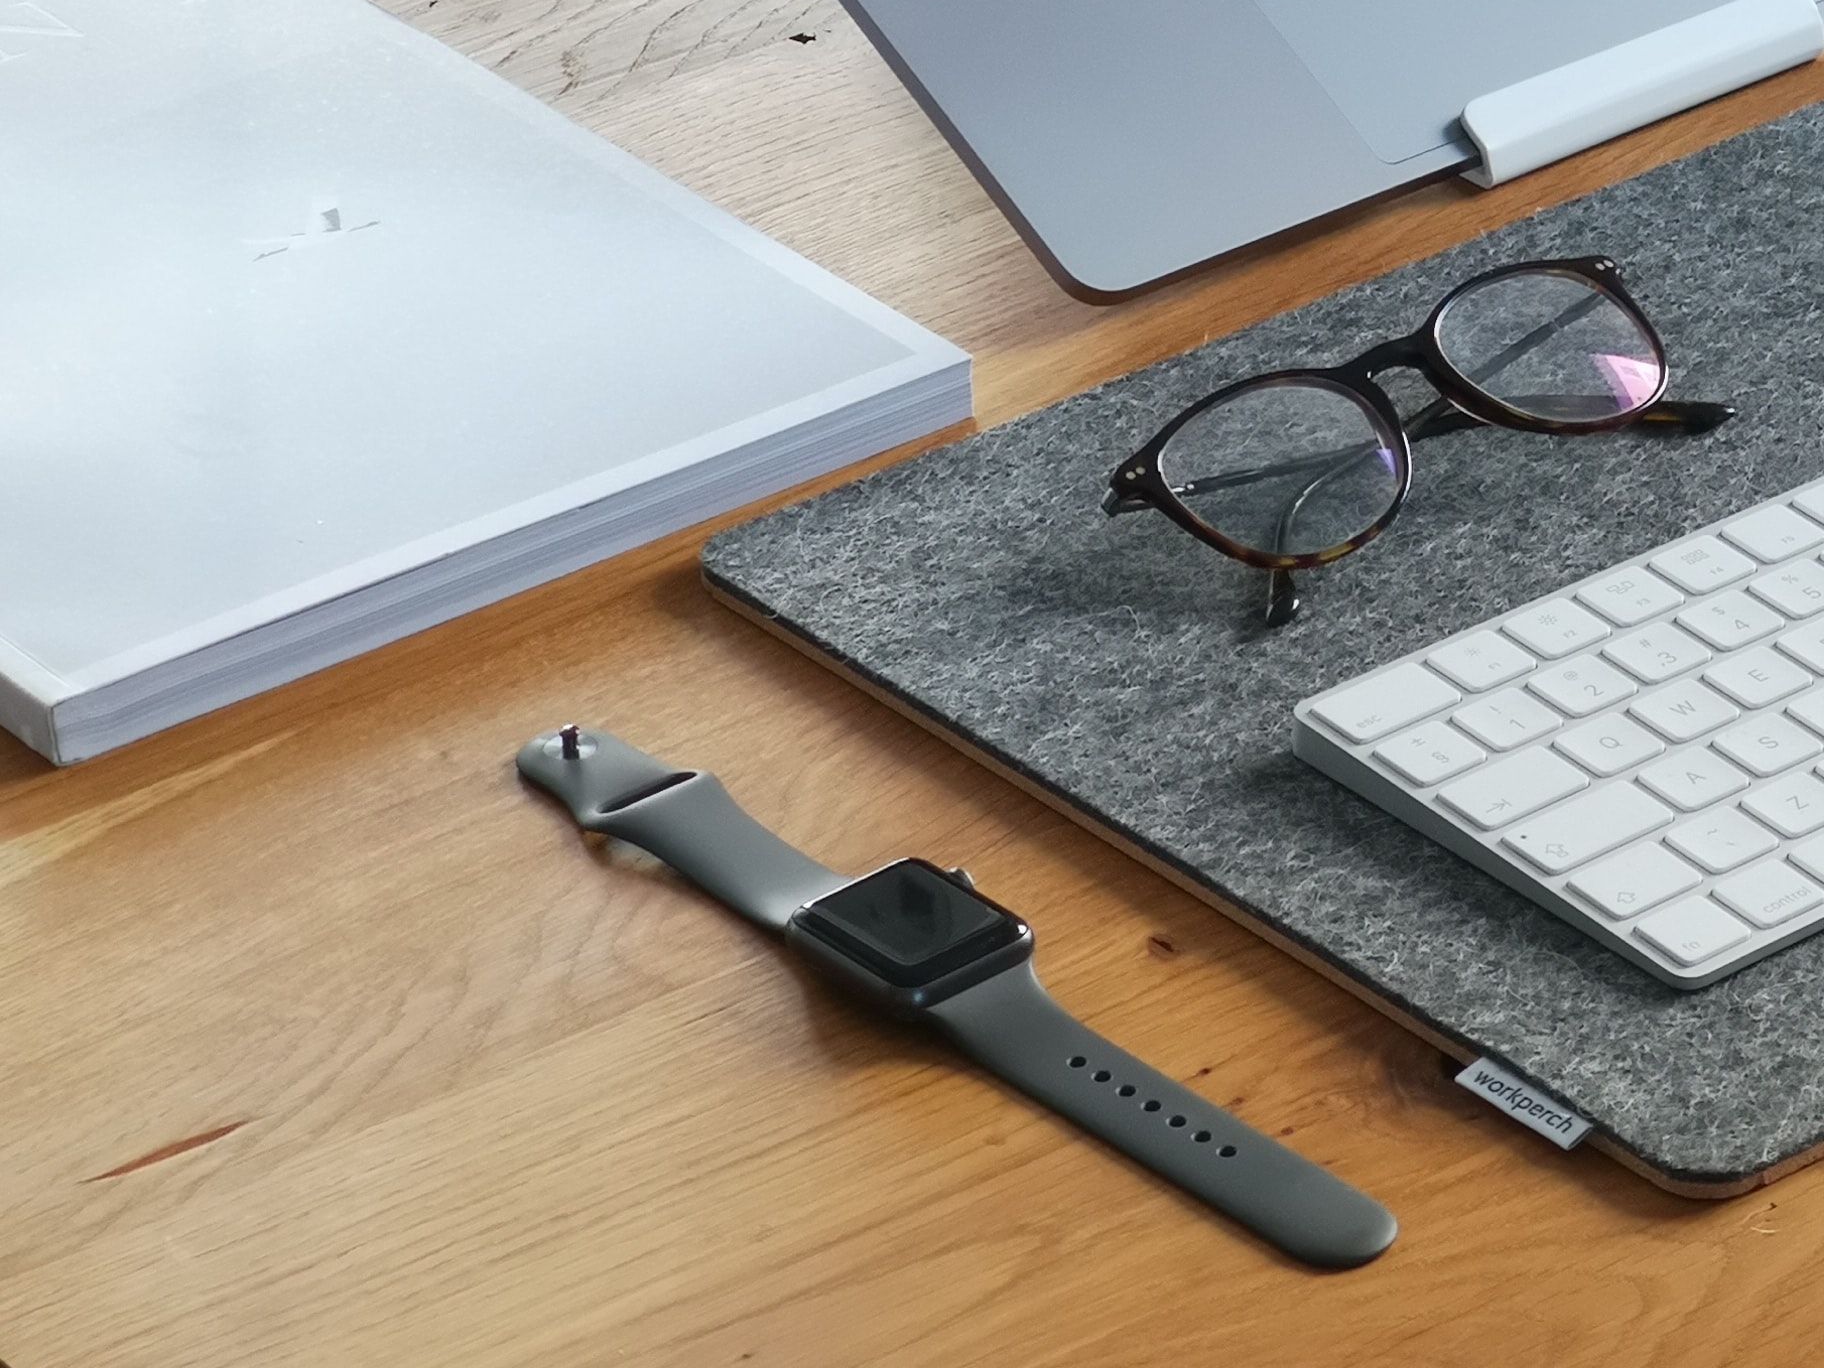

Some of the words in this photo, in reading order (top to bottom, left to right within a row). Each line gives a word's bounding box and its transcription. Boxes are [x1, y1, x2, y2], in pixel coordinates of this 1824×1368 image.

[1802, 587, 1821, 598] 5
[1735, 620, 1749, 630] 4
[1640, 639, 1651, 648] #
[1658, 652, 1677, 663] 3
[1748, 669, 1768, 682] E
[1584, 685, 1604, 696] 2
[1669, 700, 1696, 715] W
[1356, 715, 1382, 728] esc
[1510, 719, 1525, 729] 1
[1599, 737, 1623, 748] Q
[1758, 736, 1779, 748] S
[1686, 772, 1706, 784] A
[1786, 796, 1809, 810] Z
[1763, 886, 1811, 915] control
[1473, 1070, 1573, 1133] workperch
